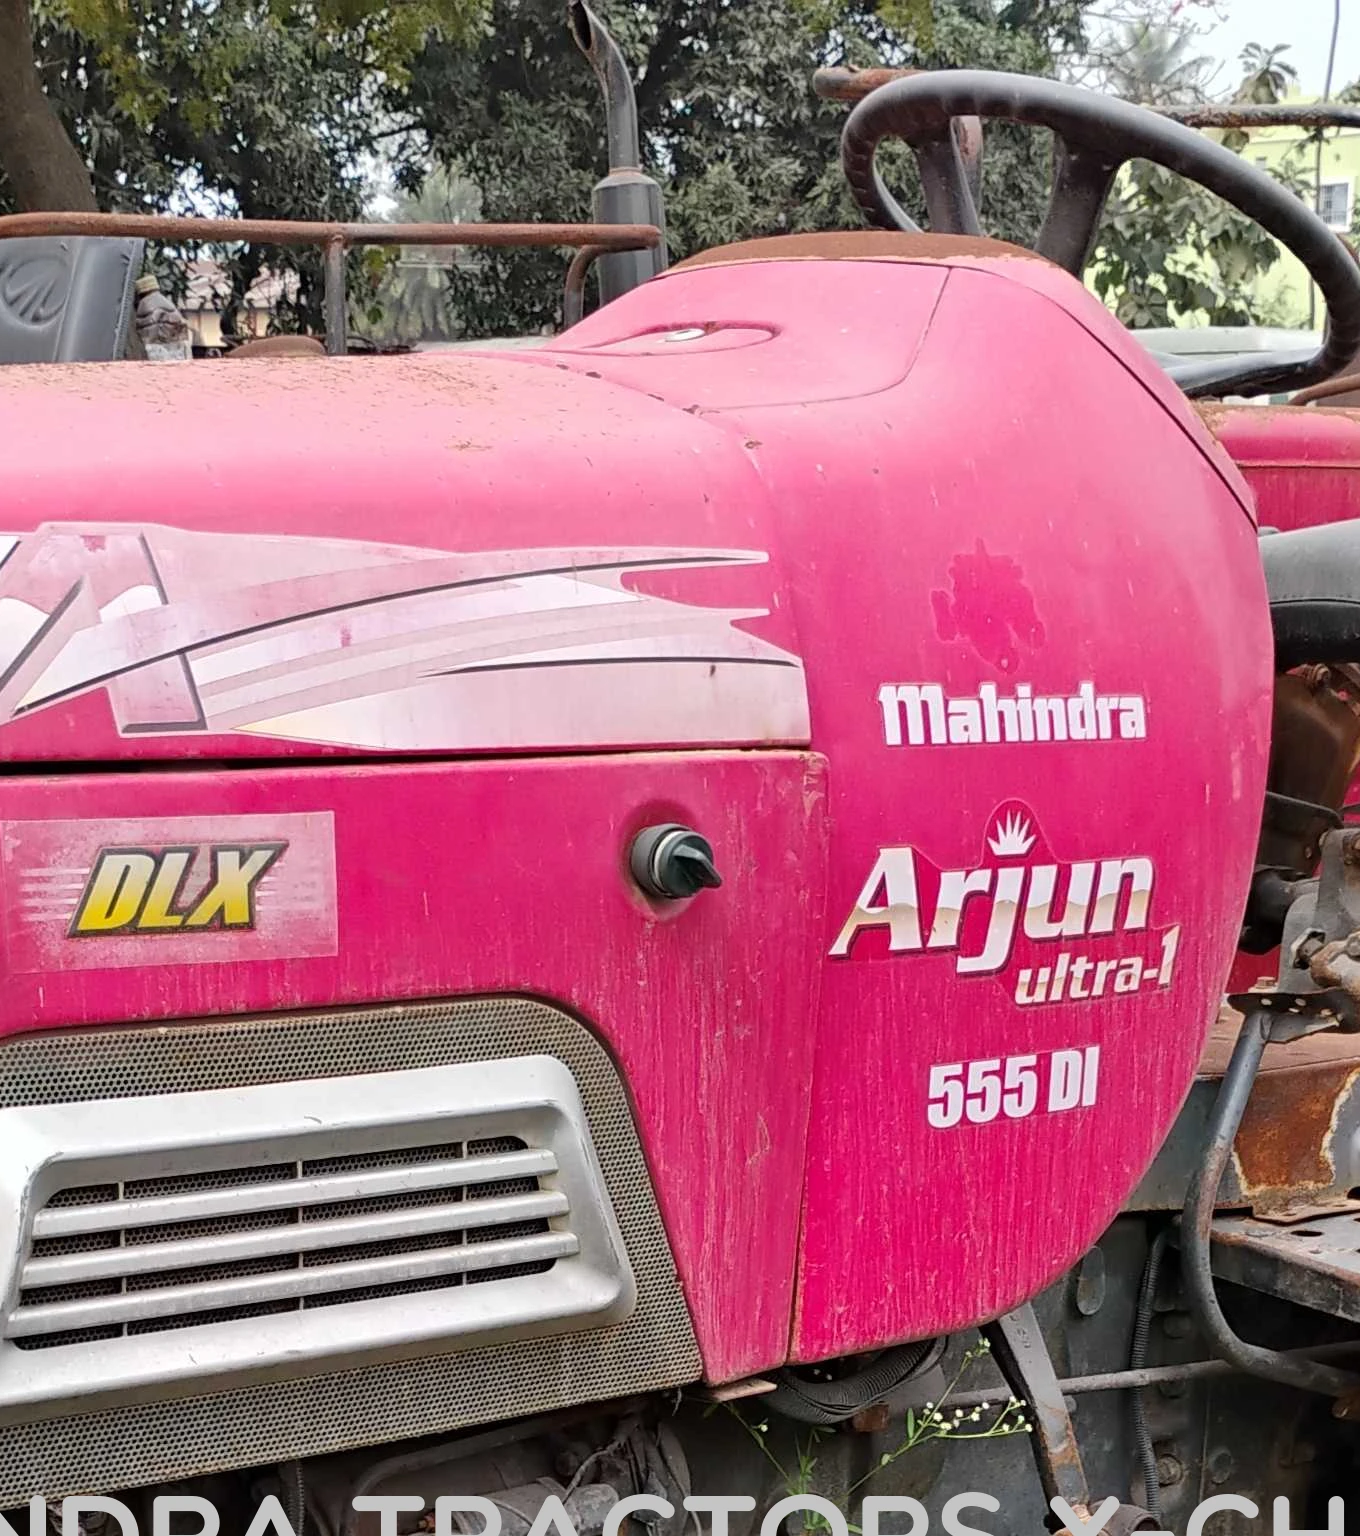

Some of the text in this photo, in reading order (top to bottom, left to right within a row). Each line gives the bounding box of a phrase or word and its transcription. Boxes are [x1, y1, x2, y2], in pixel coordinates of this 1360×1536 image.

[880, 681, 1146, 746] Mahindra
[70, 844, 286, 936] DLX
[828, 846, 1155, 975] Arjun
[1014, 925, 1182, 1007] ultra-1
[927, 1045, 1101, 1129] 555 DI
